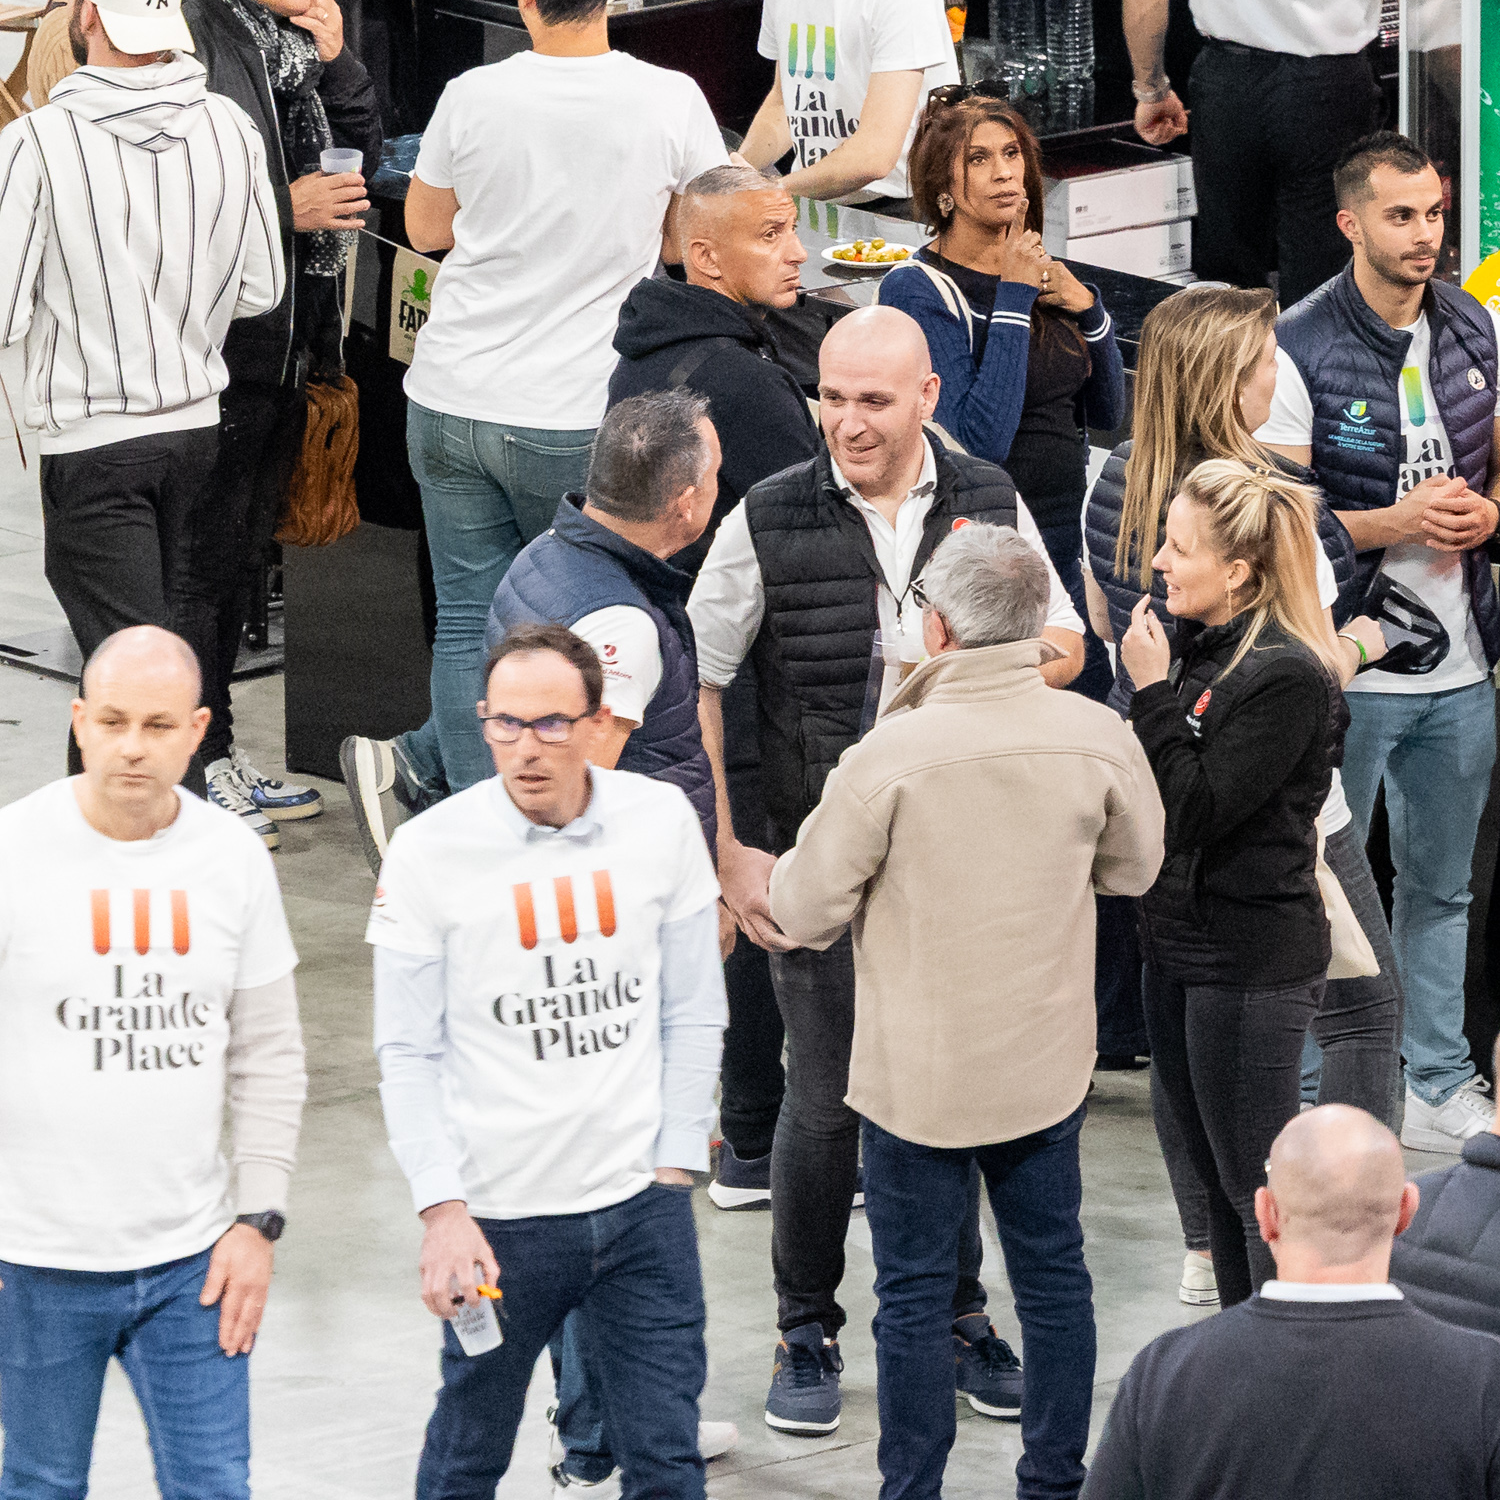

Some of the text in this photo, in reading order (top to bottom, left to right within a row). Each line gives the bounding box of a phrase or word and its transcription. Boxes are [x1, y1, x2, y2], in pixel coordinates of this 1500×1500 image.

[795, 84, 827, 112] La
[787, 108, 860, 139] rande
[399, 299, 429, 332] FAD
[1340, 422, 1377, 436] TerreAzur
[1400, 434, 1445, 464] La
[114, 964, 163, 999] La
[544, 955, 598, 989] La
[55, 991, 210, 1032] Grande
[492, 971, 643, 1027] Grande
[94, 1033, 204, 1071] Place
